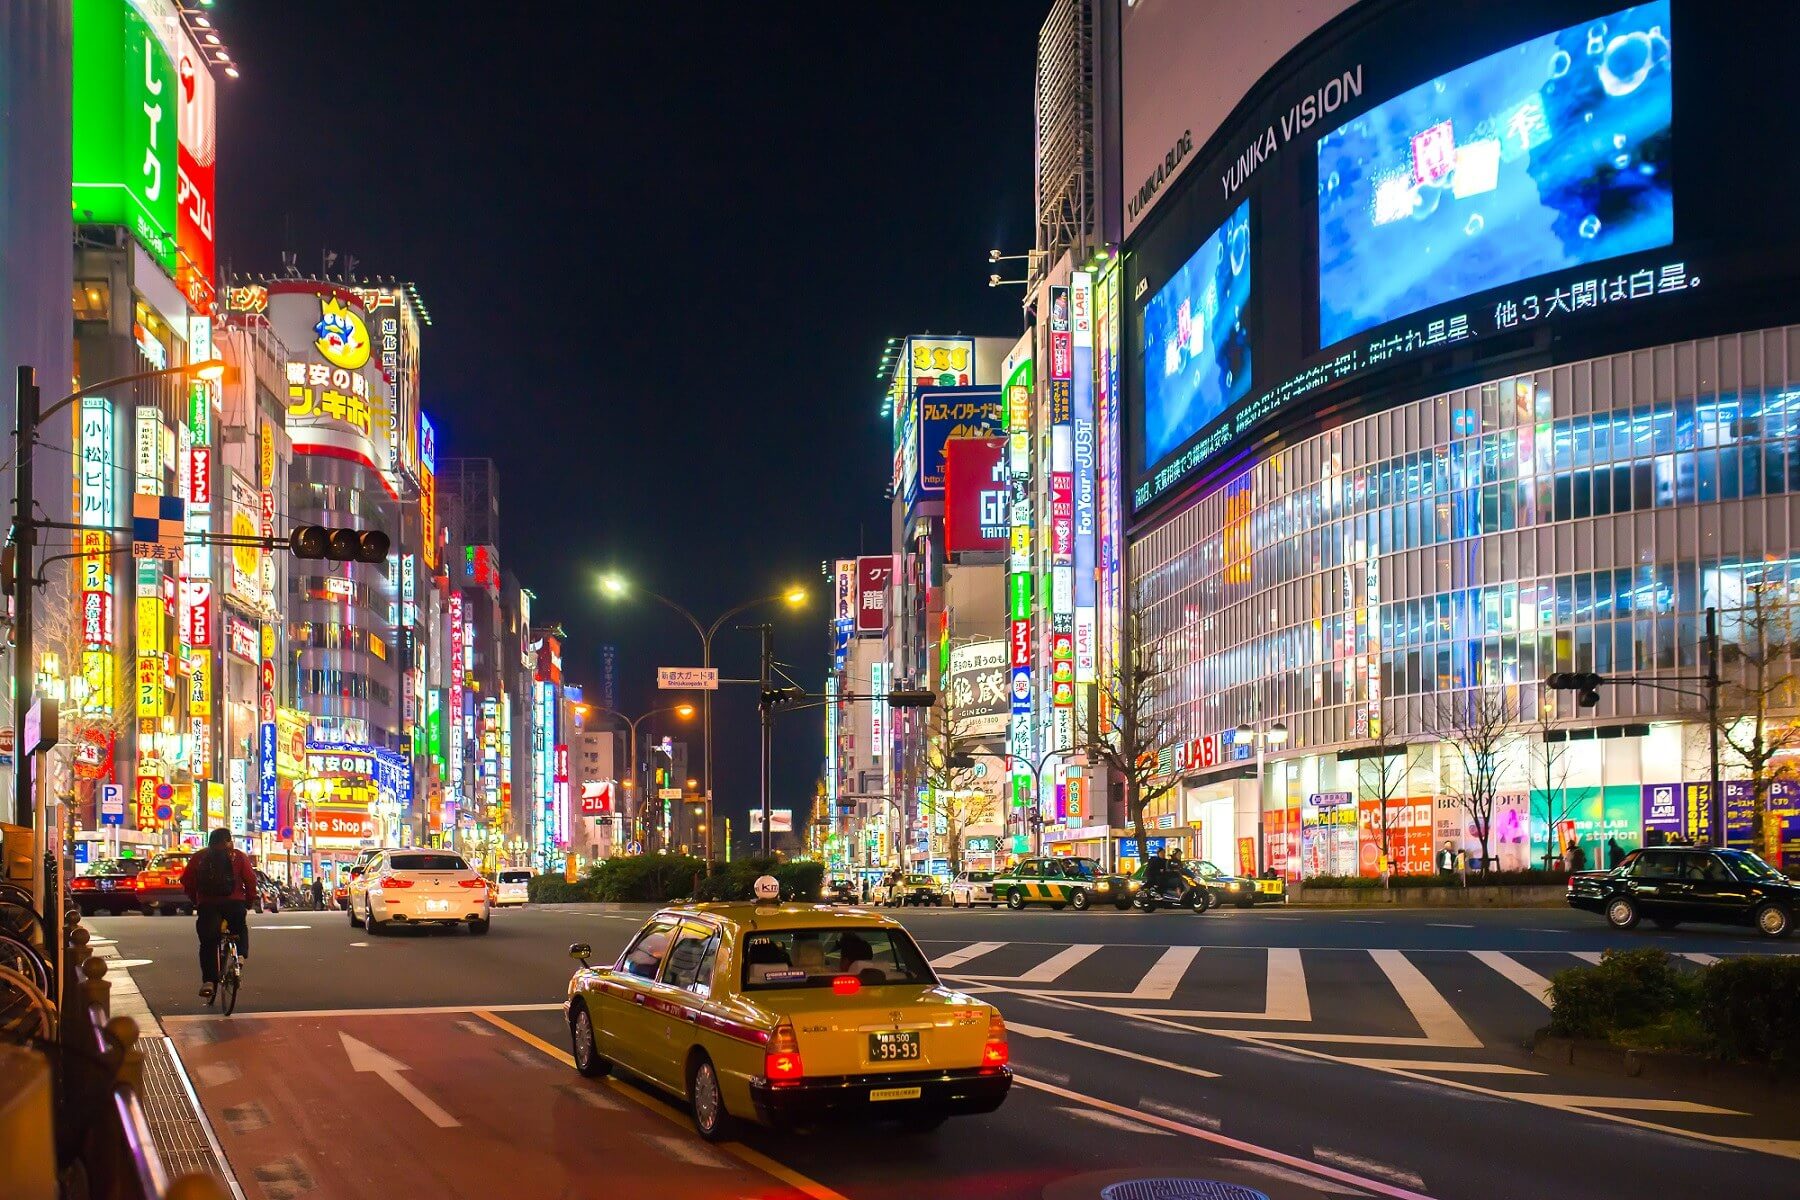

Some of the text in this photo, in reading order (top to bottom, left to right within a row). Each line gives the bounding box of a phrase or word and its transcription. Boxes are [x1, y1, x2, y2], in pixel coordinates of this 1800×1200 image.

[1222, 65, 1363, 200] YUNIKA VISION
[1127, 163, 1165, 223] YUNIKA
[1076, 287, 1085, 317] LABI
[85, 420, 101, 512] 小松ビル
[1075, 417, 1092, 536] For Your JUST
[194, 461, 206, 503] アイフル
[134, 543, 183, 560] 時差式
[1016, 621, 1029, 664] アイフル
[1078, 624, 1088, 654] LABI
[662, 670, 715, 681] 新宿大ガード東
[1184, 735, 1218, 770] LABI
[1727, 784, 1744, 796] B2
[1771, 782, 1789, 795] B1
[331, 818, 359, 835] Shop
[880, 1042, 918, 1059] 99-93
[895, 1033, 909, 1042] 500
